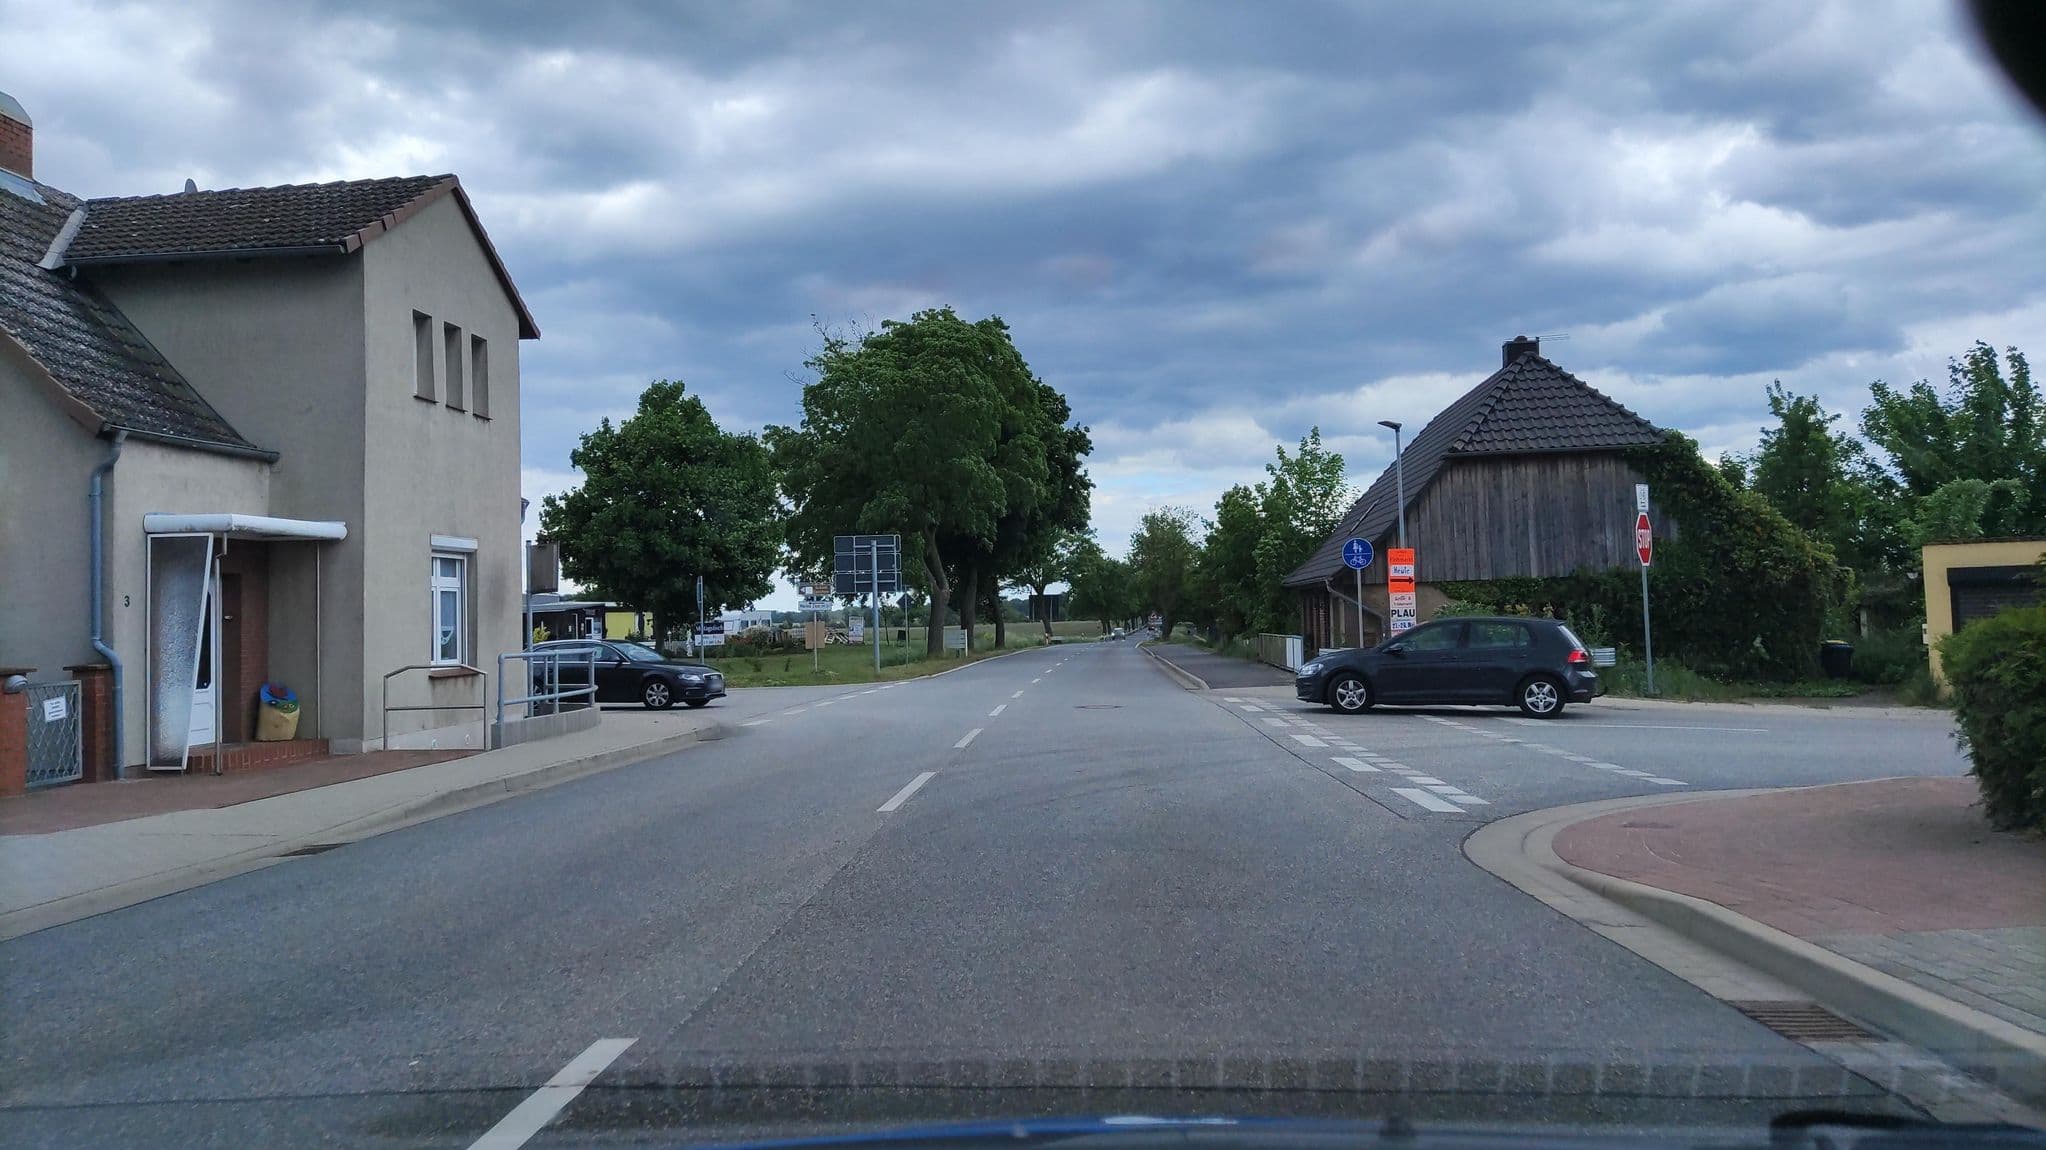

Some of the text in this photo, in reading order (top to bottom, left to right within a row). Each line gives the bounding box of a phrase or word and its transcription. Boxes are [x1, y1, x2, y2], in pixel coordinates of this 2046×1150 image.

[1638, 528, 1650, 549] STOP
[124, 595, 130, 607] 3
[1391, 609, 1415, 618] PLAU
